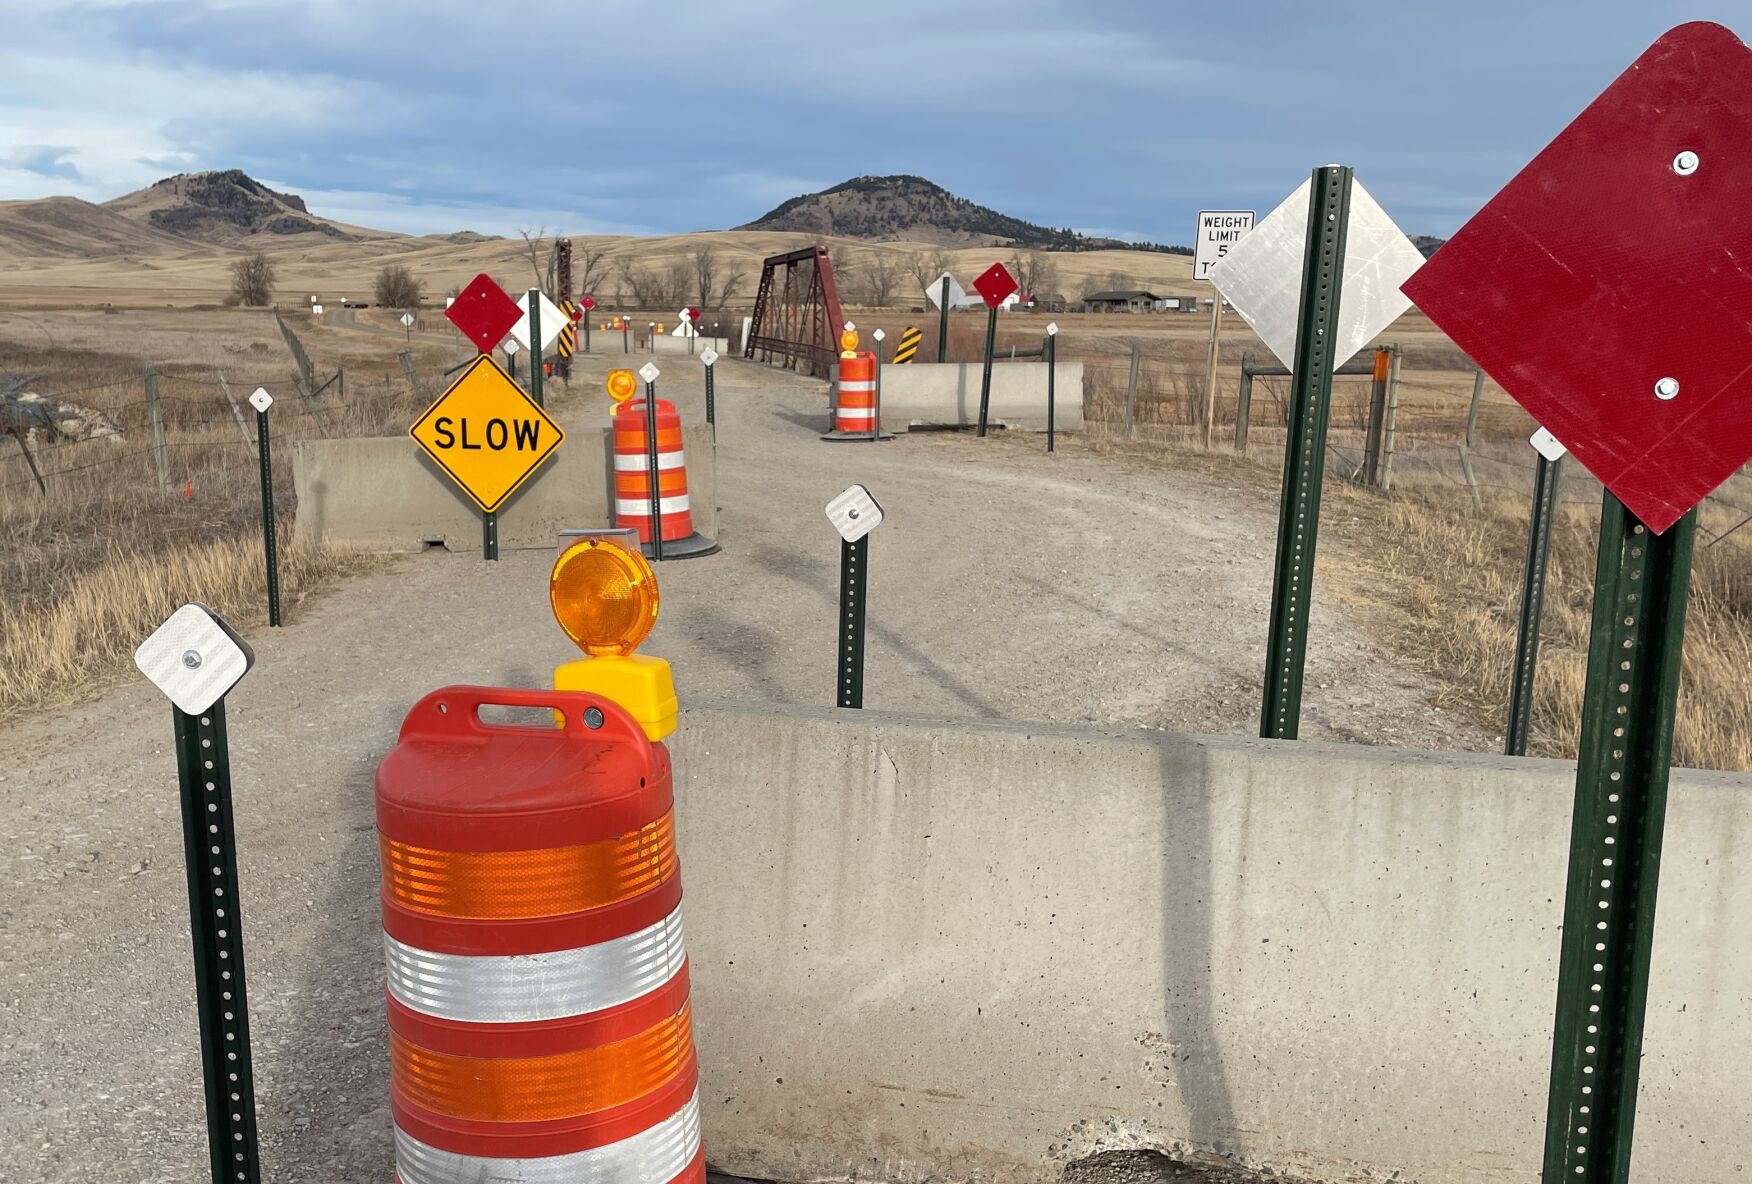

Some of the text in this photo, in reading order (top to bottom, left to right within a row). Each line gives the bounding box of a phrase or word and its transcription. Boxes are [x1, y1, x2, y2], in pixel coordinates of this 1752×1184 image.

[1204, 217, 1249, 227] WEIGHT
[1208, 231, 1240, 241] LIMIT
[1217, 245, 1228, 257] 5
[434, 416, 540, 451] SLOW
